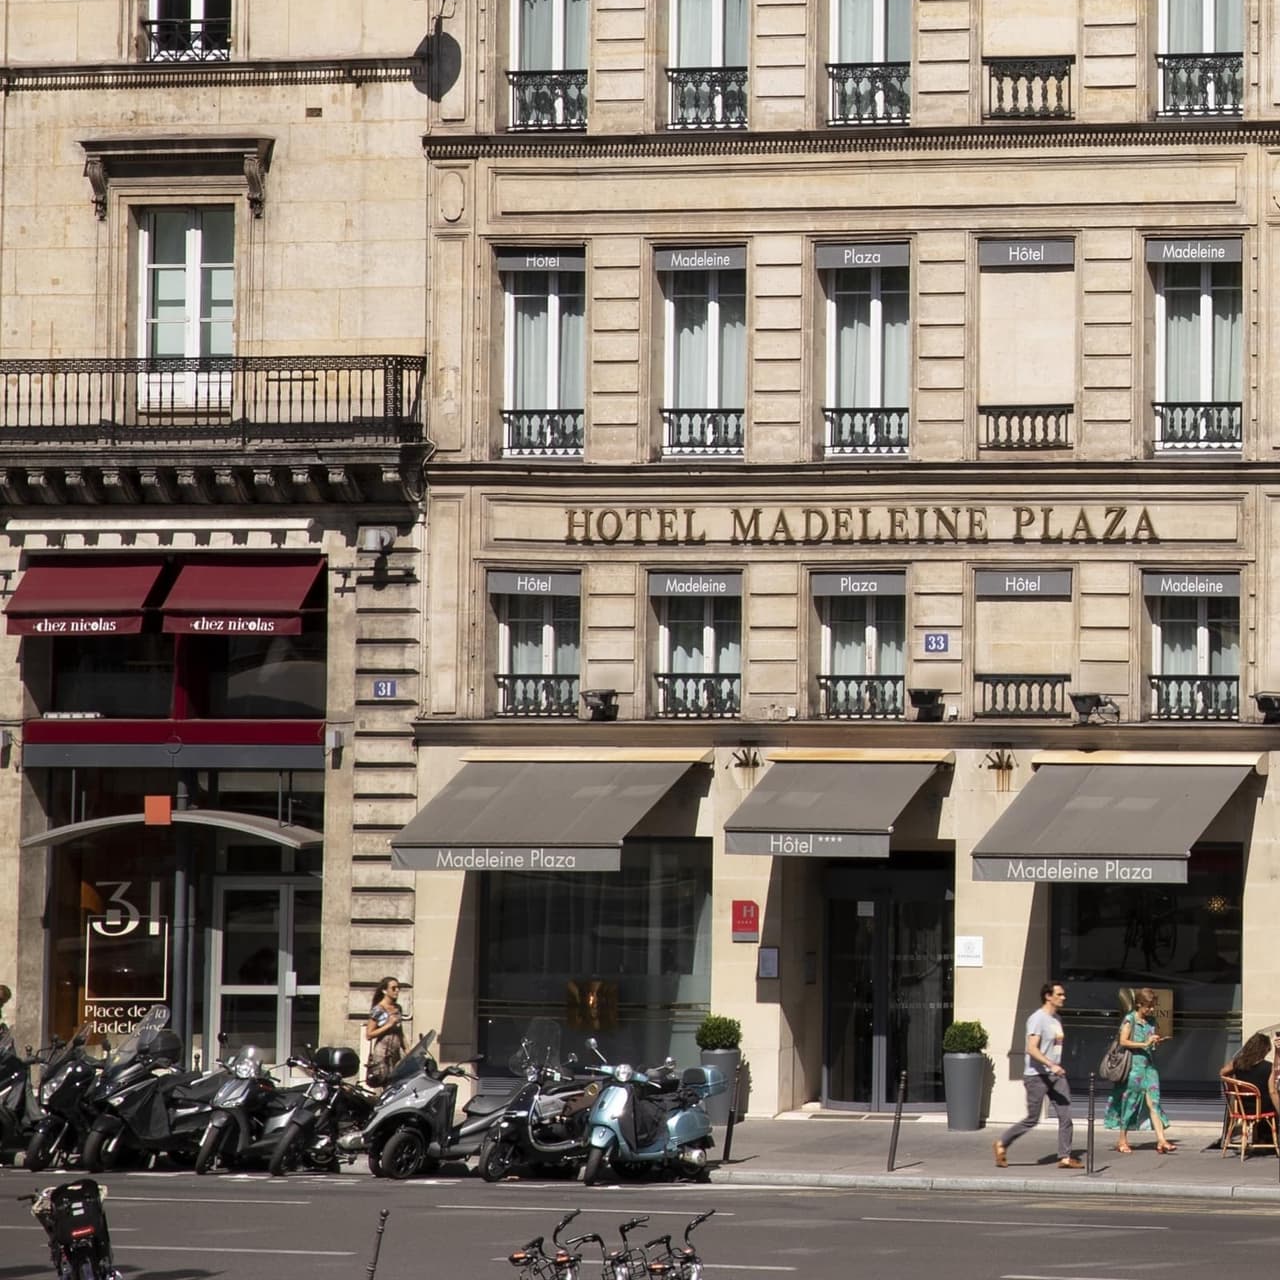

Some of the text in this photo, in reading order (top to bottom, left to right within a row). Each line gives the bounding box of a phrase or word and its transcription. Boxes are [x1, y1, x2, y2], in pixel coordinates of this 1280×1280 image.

[844, 249, 880, 264] Plaza
[1009, 245, 1044, 261] Hôtel
[1162, 242, 1225, 259] Madeleine
[526, 252, 560, 268] Hôtel
[671, 251, 731, 267] Madeleine
[565, 506, 1161, 544] HOTEL MADELEINE PLAZA
[517, 575, 552, 592] Hôtel
[665, 577, 727, 593] Madeleine
[840, 576, 878, 592] Plaza
[1005, 575, 1041, 591] Hôtel
[1160, 577, 1223, 593] Madeleine
[34, 618, 117, 632] chez nicolas
[191, 617, 275, 631] chez nicolas
[928, 635, 945, 650] 33
[378, 682, 392, 696] 31
[770, 835, 813, 853] Hôtel
[436, 848, 576, 868] Madeleine Plaza
[1007, 860, 1153, 880] Madeleine Plaza
[92, 881, 161, 936] 31
[743, 906, 755, 918] H
[84, 1004, 124, 1018] Place
[127, 1004, 147, 1018] de
